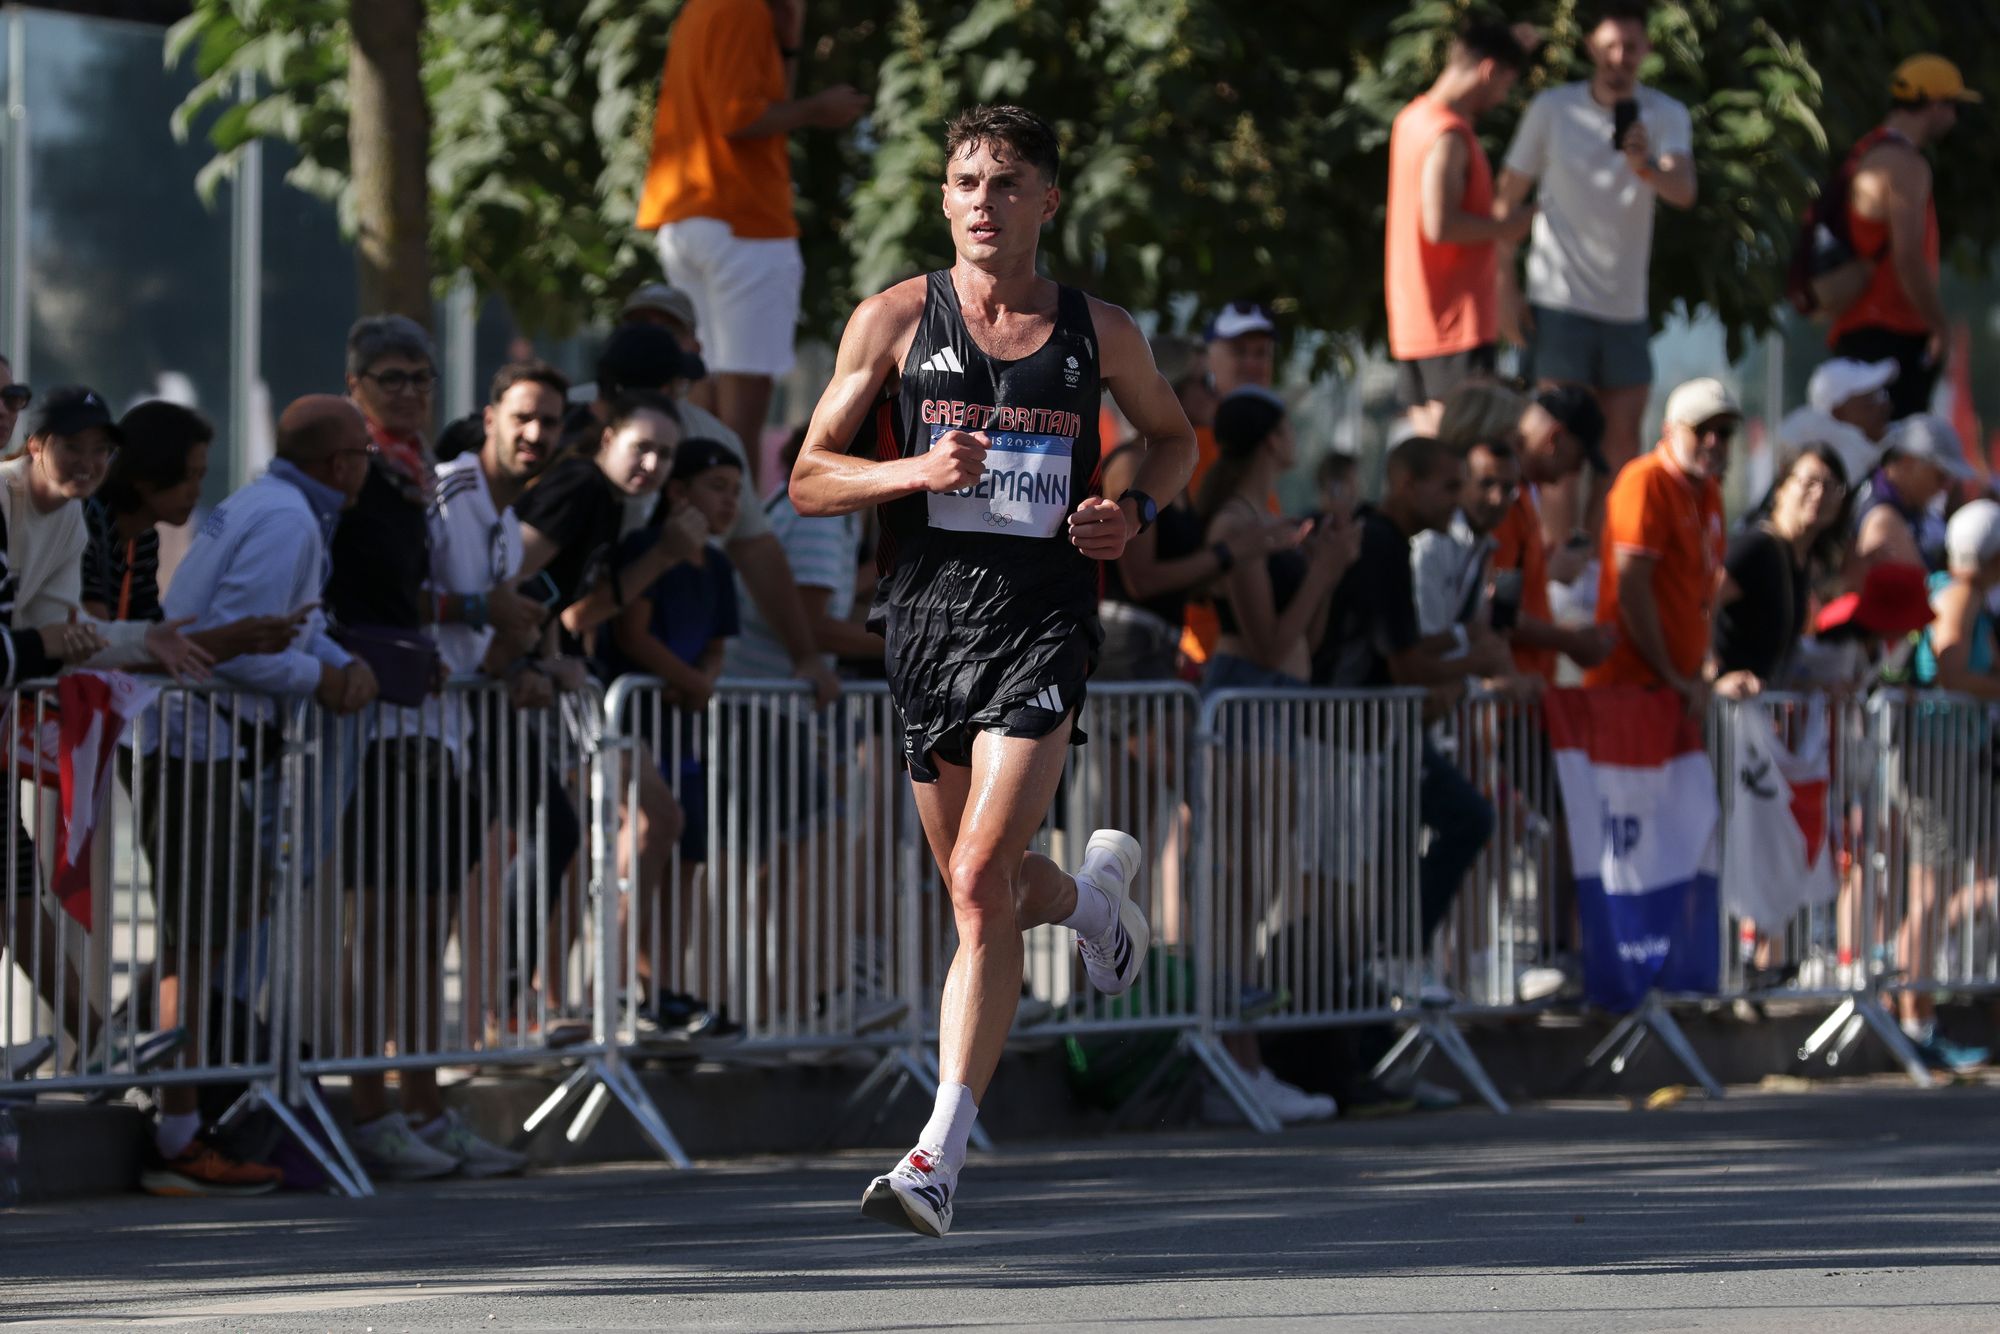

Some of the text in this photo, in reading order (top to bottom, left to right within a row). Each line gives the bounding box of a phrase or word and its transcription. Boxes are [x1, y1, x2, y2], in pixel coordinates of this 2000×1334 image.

[921, 398, 1081, 438] GREAT BRITAIN
[1006, 437, 1041, 448] 2024
